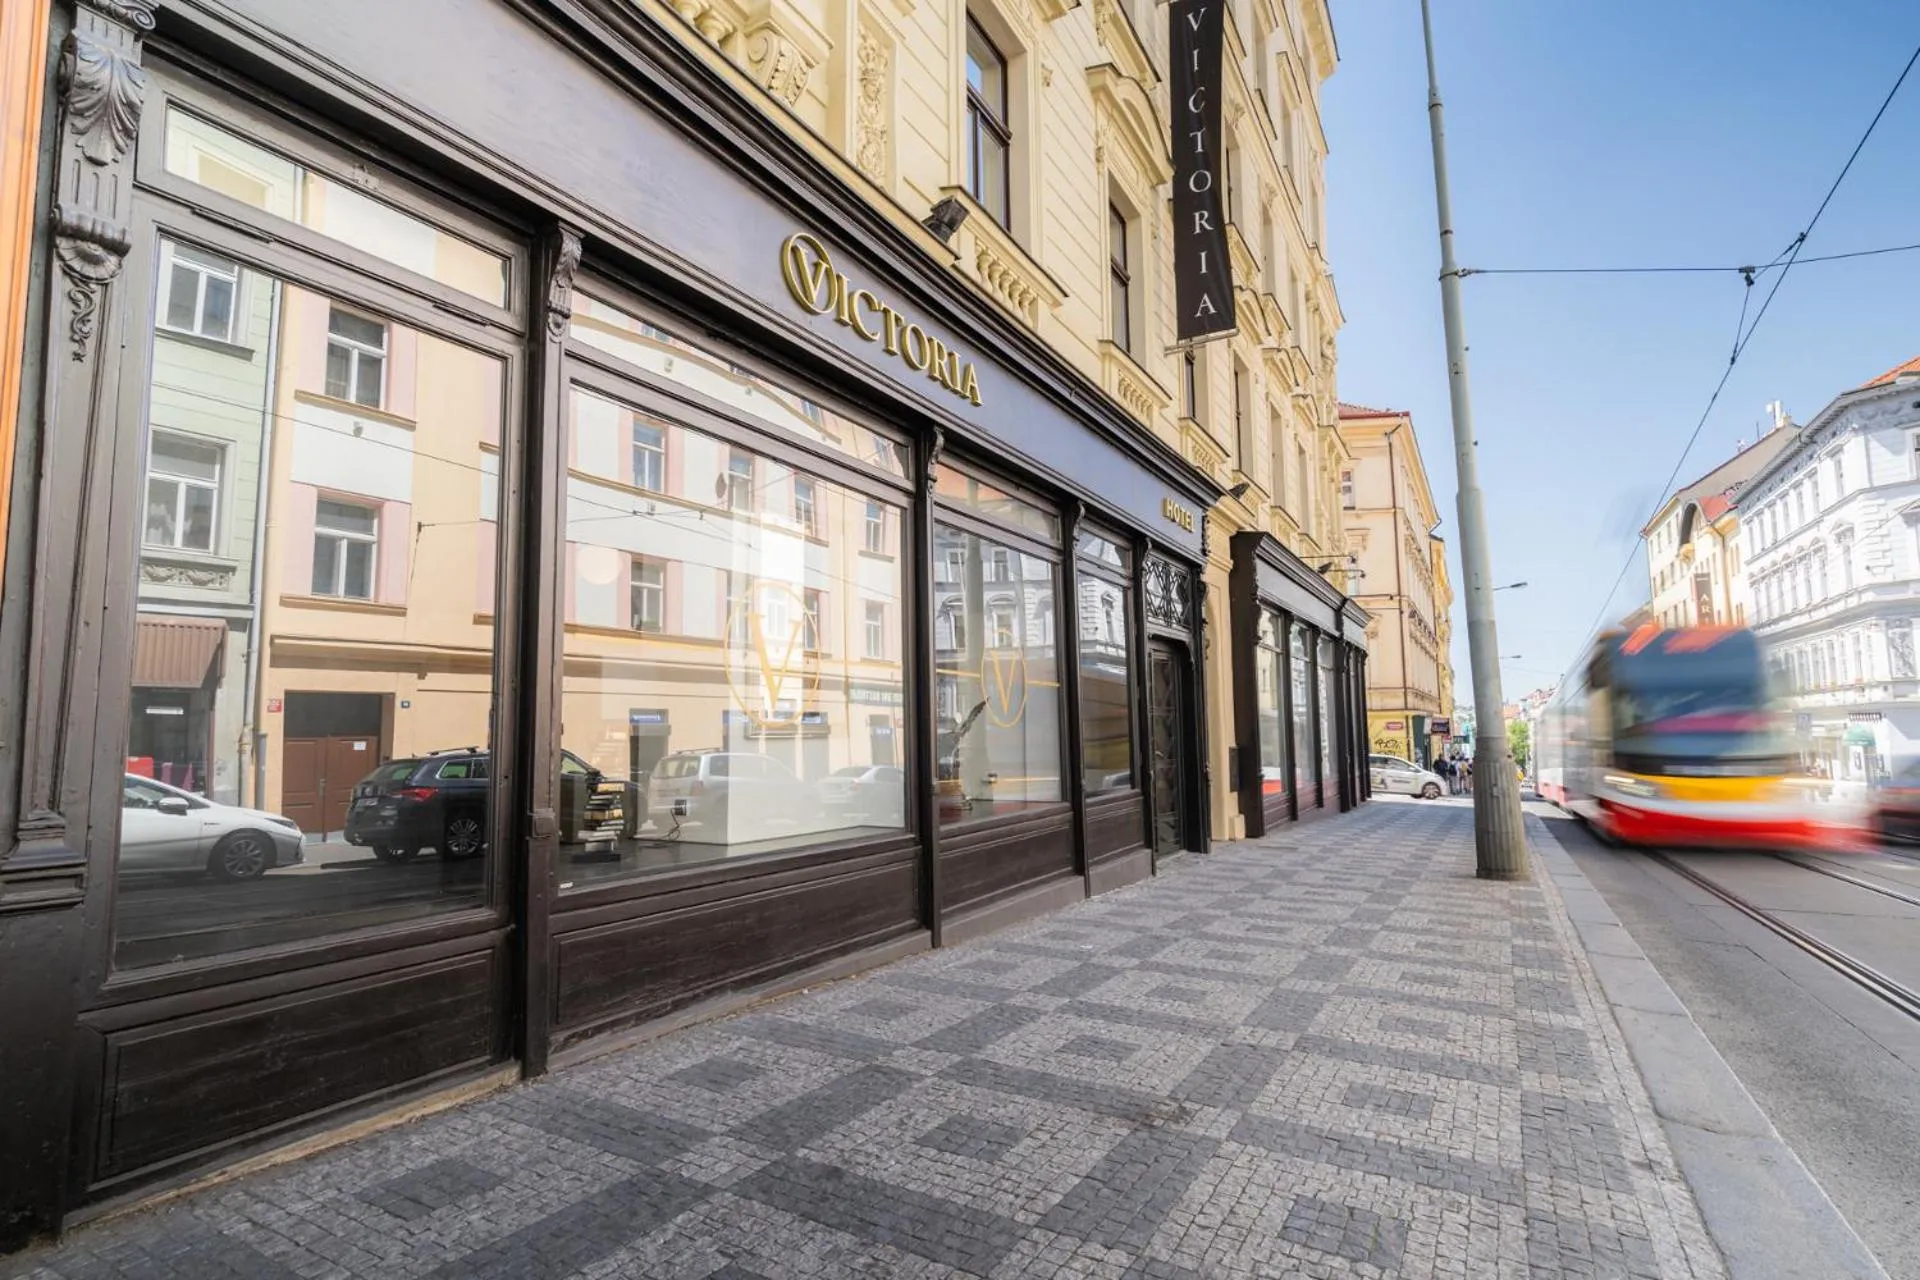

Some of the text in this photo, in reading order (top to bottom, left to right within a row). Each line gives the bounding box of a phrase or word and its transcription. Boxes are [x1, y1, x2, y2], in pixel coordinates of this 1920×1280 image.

[1186, 8, 1217, 317] VICTORIA
[781, 232, 984, 406] VICTORIA
[1162, 497, 1196, 533] HOTEL
[745, 613, 803, 710] V
